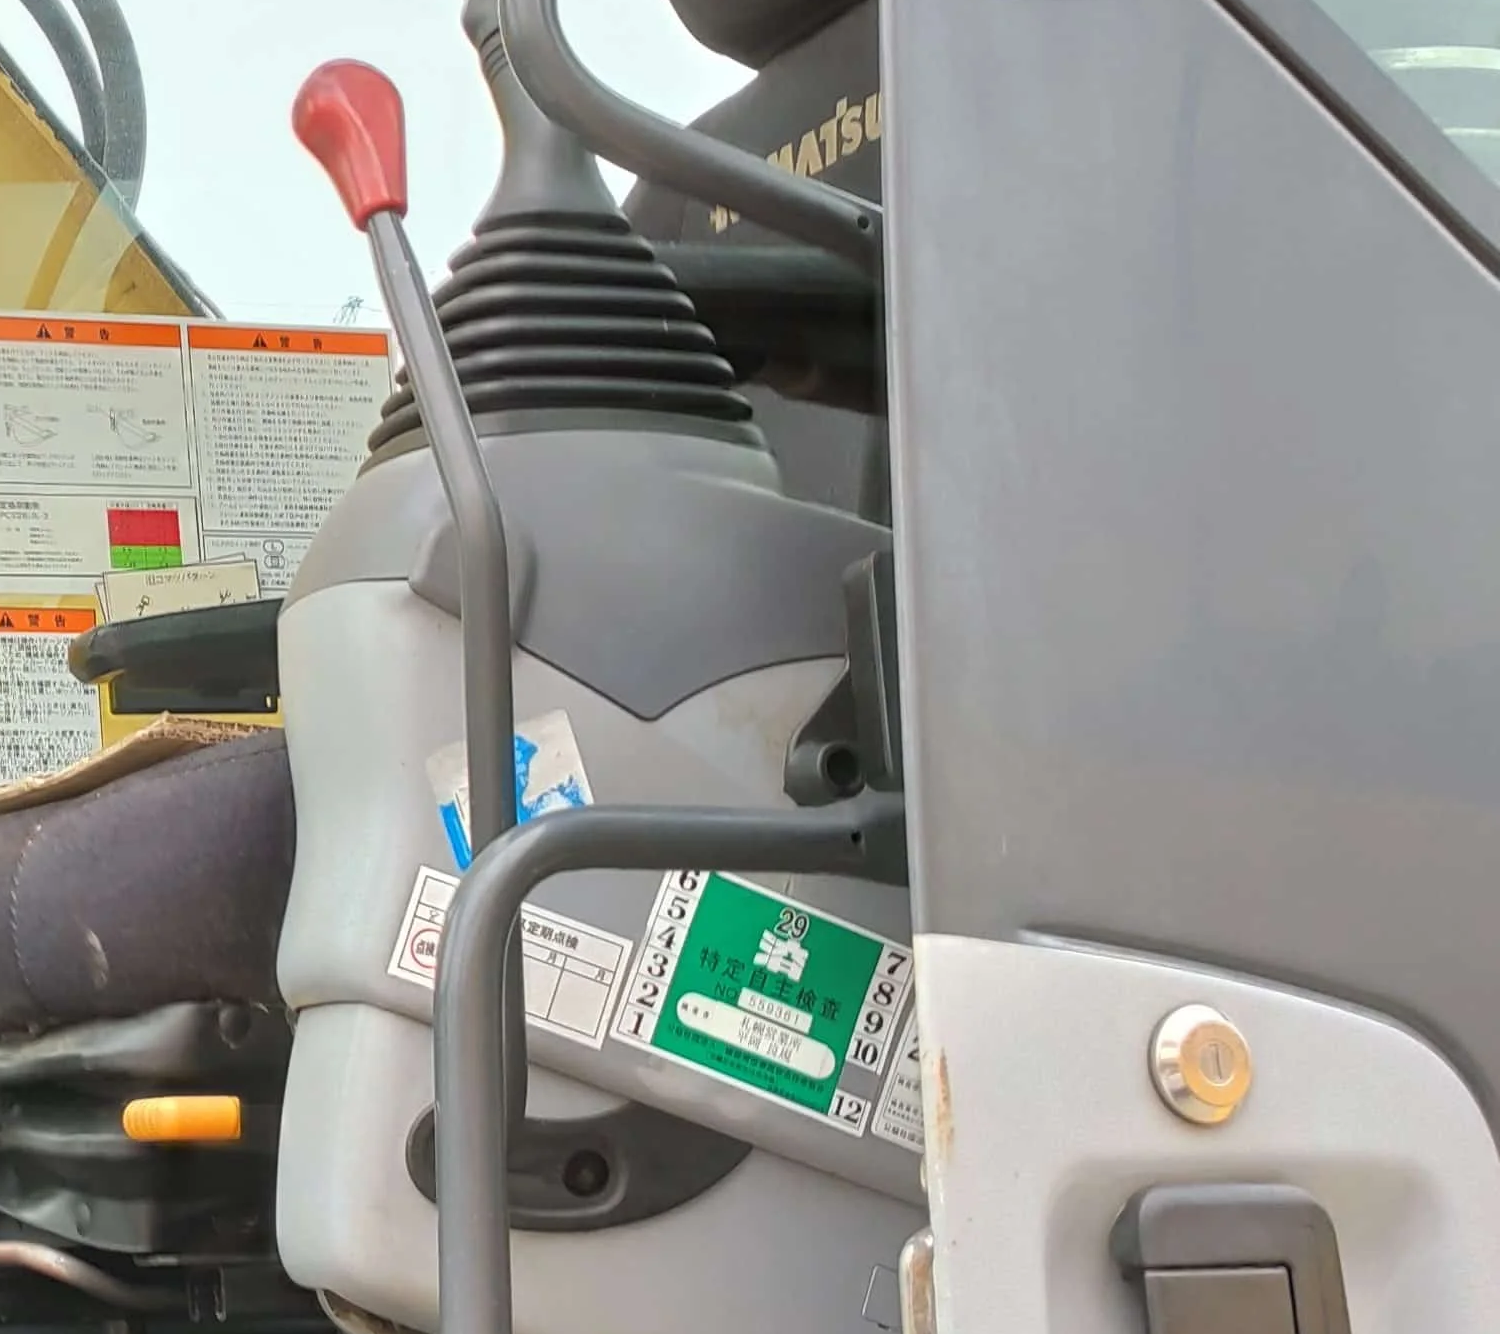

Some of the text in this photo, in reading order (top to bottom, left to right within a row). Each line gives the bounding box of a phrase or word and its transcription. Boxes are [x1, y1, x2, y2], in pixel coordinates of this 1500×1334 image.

[28, 614, 66, 628] 警告
[680, 870, 699, 892] 6
[668, 897, 689, 920] 5
[774, 907, 810, 939] 29
[657, 926, 676, 950] 4
[647, 953, 669, 978] 3
[885, 952, 908, 976] 7
[637, 983, 659, 1007] 2
[700, 946, 842, 1021] 特定自主検査
[872, 982, 896, 1006] 8
[628, 1012, 645, 1035] 1
[863, 1010, 885, 1035] 9
[852, 1040, 878, 1065] 10
[835, 1095, 862, 1124] 12
